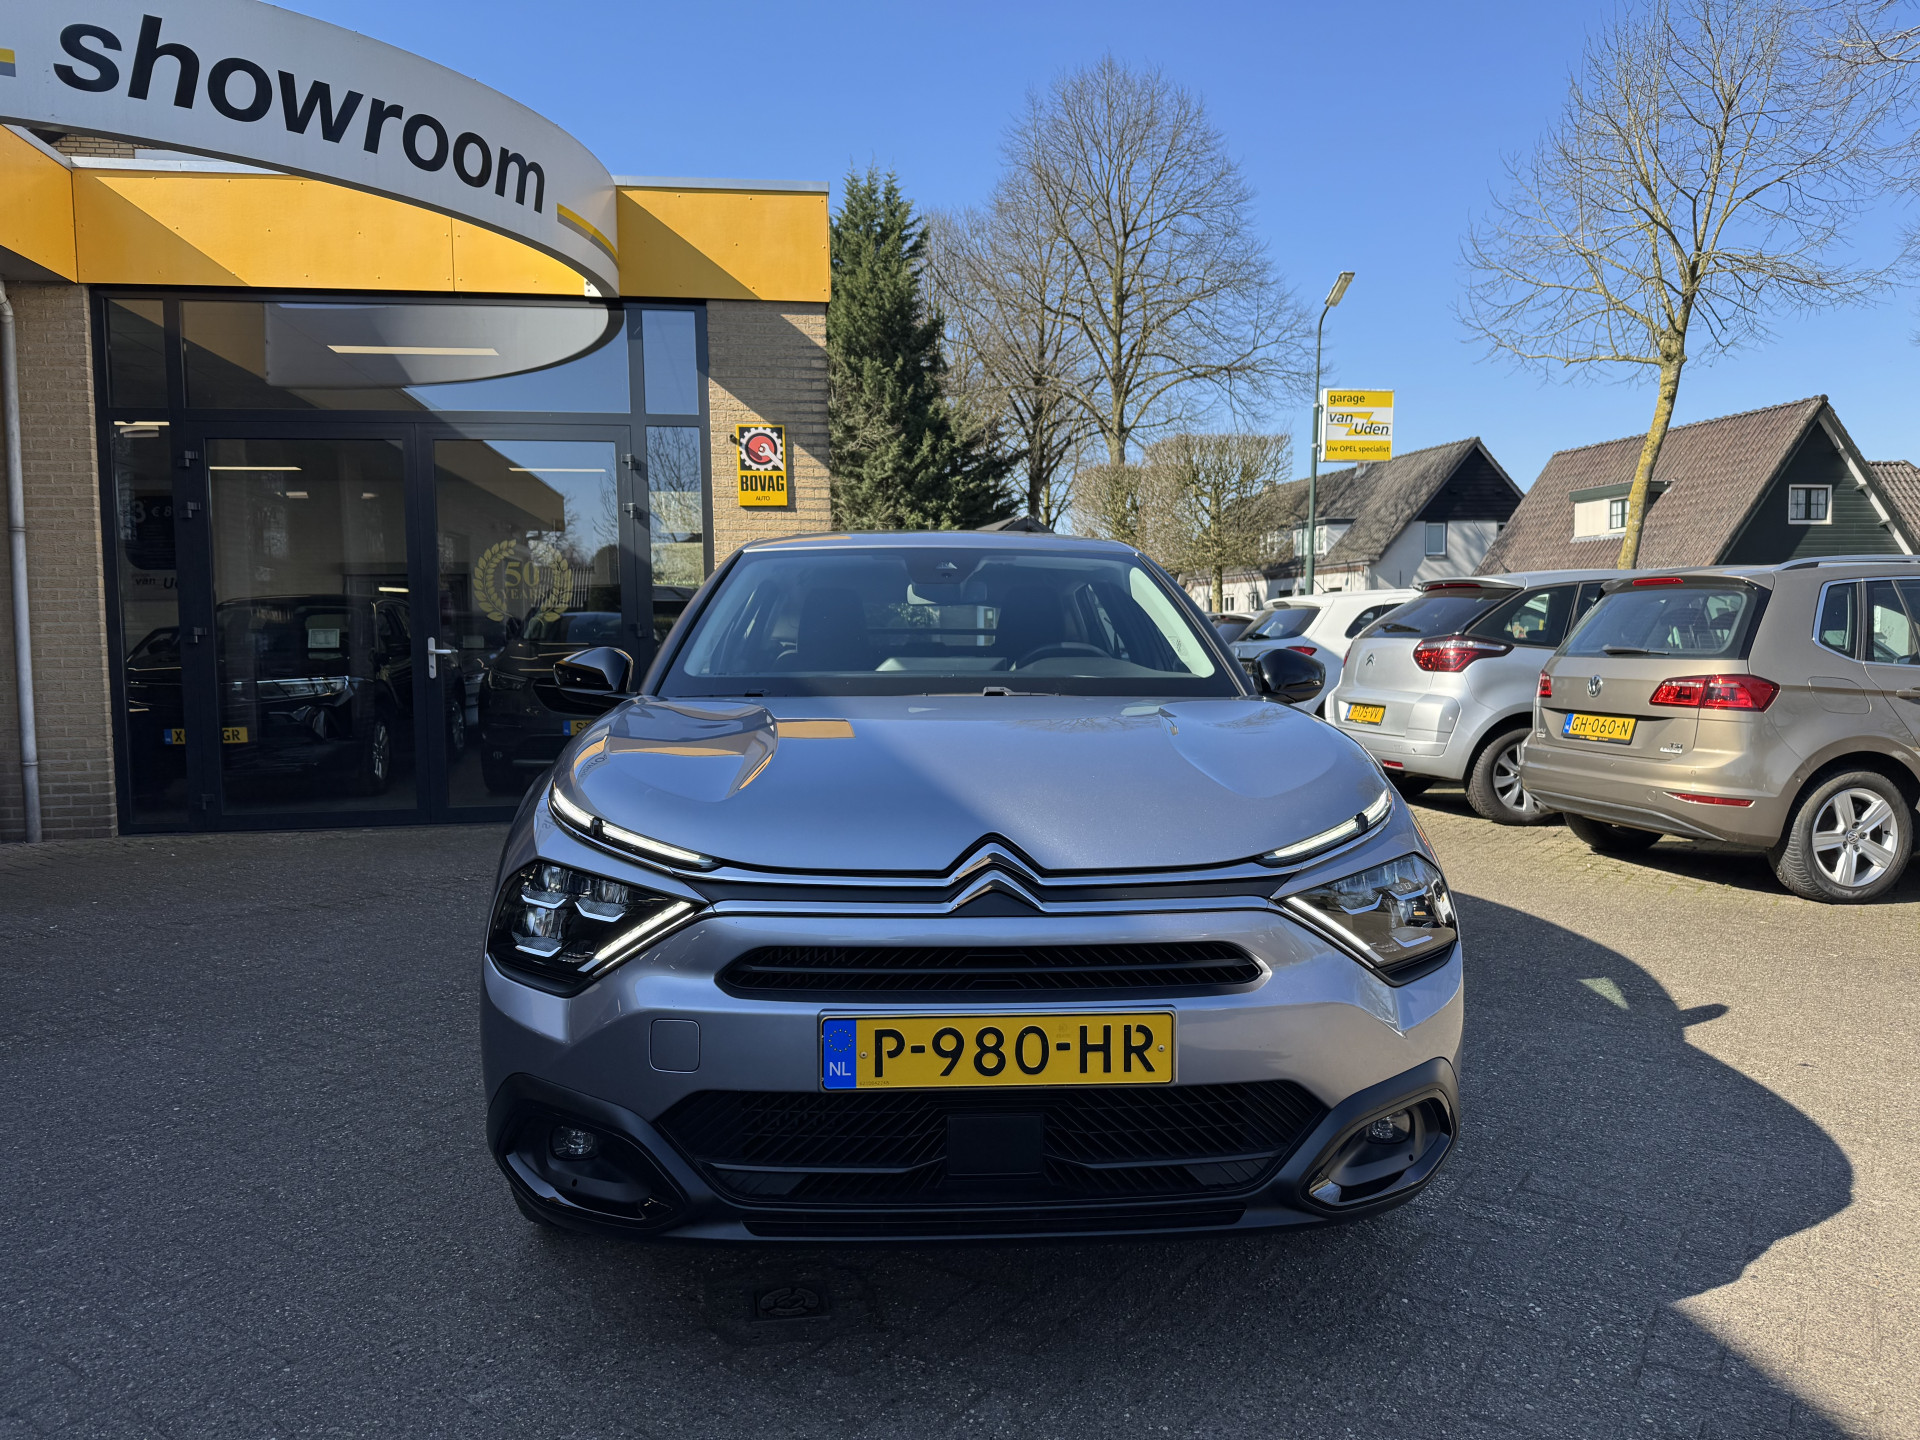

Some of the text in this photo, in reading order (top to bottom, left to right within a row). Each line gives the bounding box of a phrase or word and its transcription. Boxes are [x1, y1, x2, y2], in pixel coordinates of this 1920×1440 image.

[53, 14, 546, 214] showroom
[1329, 394, 1366, 404] garage
[1329, 413, 1354, 423] van
[1354, 422, 1389, 435] Uden
[1358, 445, 1389, 453] specialist
[740, 474, 785, 492] BOVAG
[135, 577, 156, 586] van
[504, 561, 540, 587] 50
[1571, 716, 1631, 737] GH-060-N
[828, 1023, 1156, 1078] NL P-980-HR
